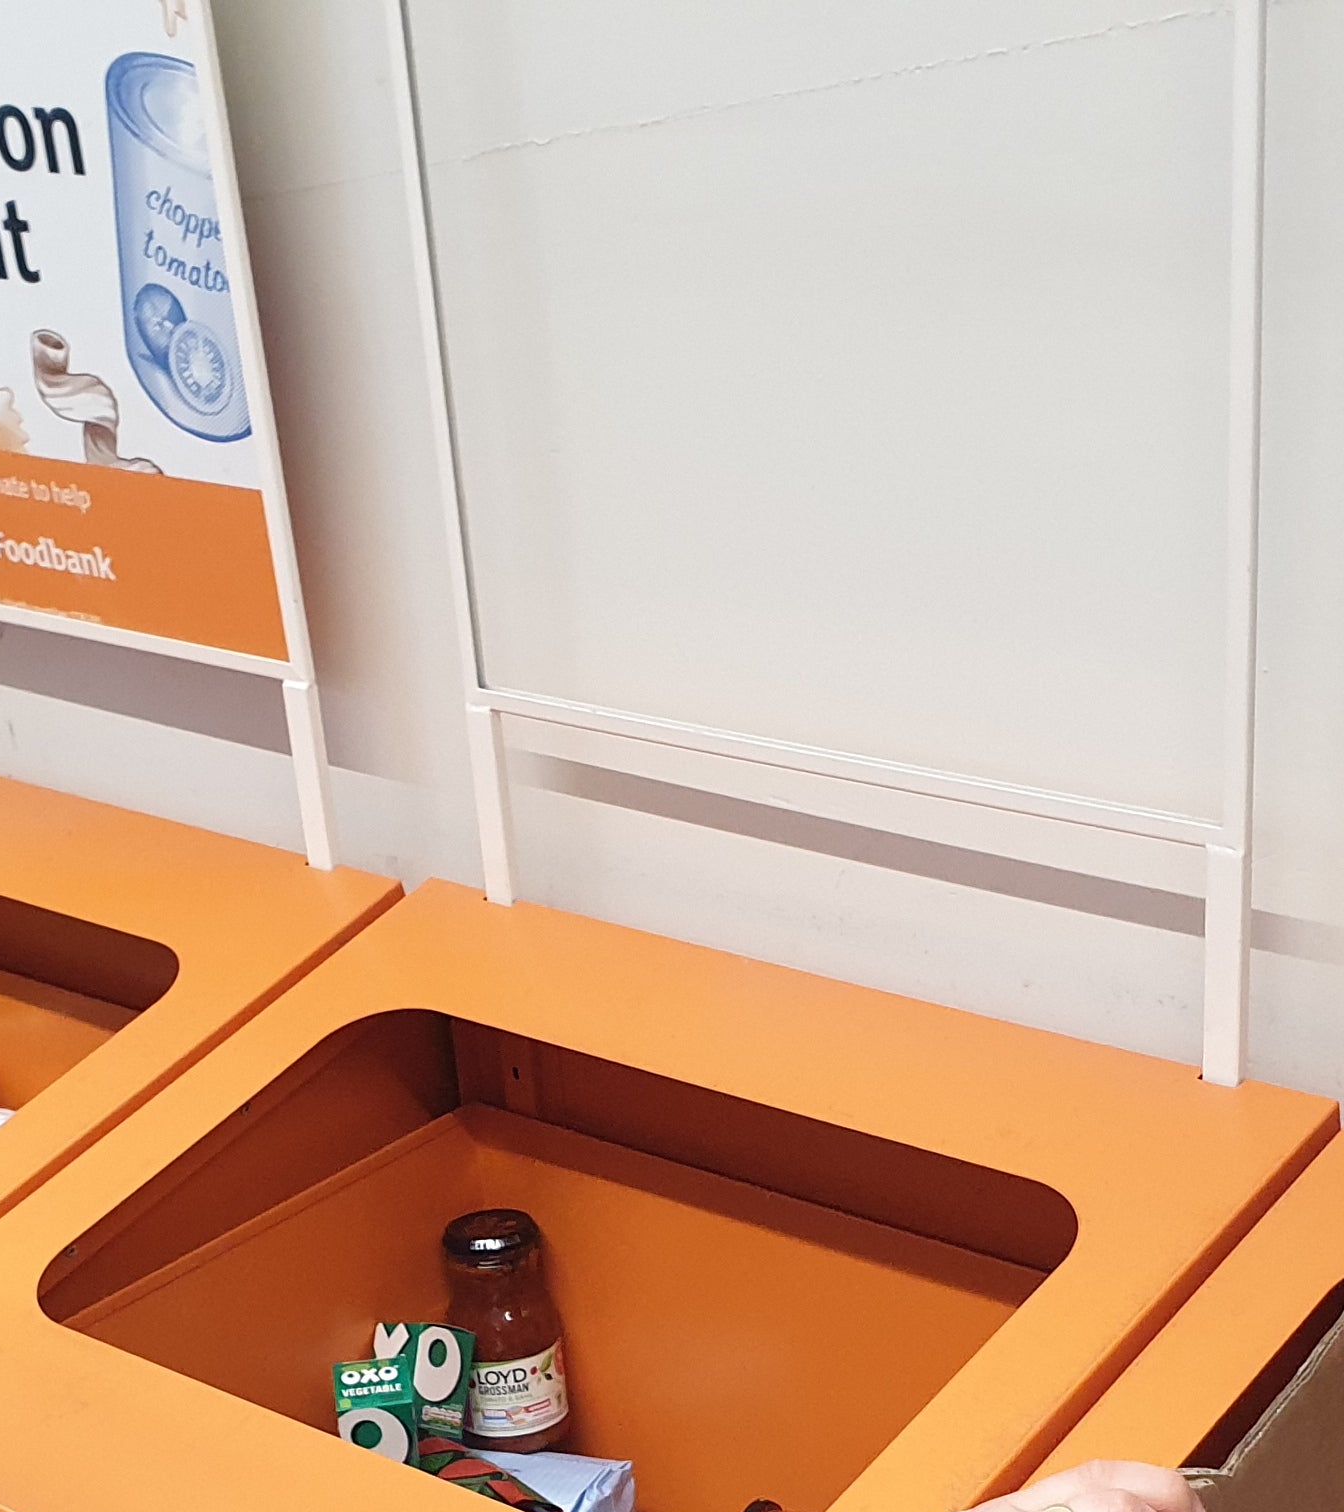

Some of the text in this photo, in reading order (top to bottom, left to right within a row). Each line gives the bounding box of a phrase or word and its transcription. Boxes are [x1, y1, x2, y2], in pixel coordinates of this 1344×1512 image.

[31, 480, 50, 502] to
[50, 481, 91, 514] help
[340, 1365, 399, 1385] OXO
[341, 1383, 402, 1397] VEGETABLE
[478, 1382, 529, 1396] GROSSMAN
